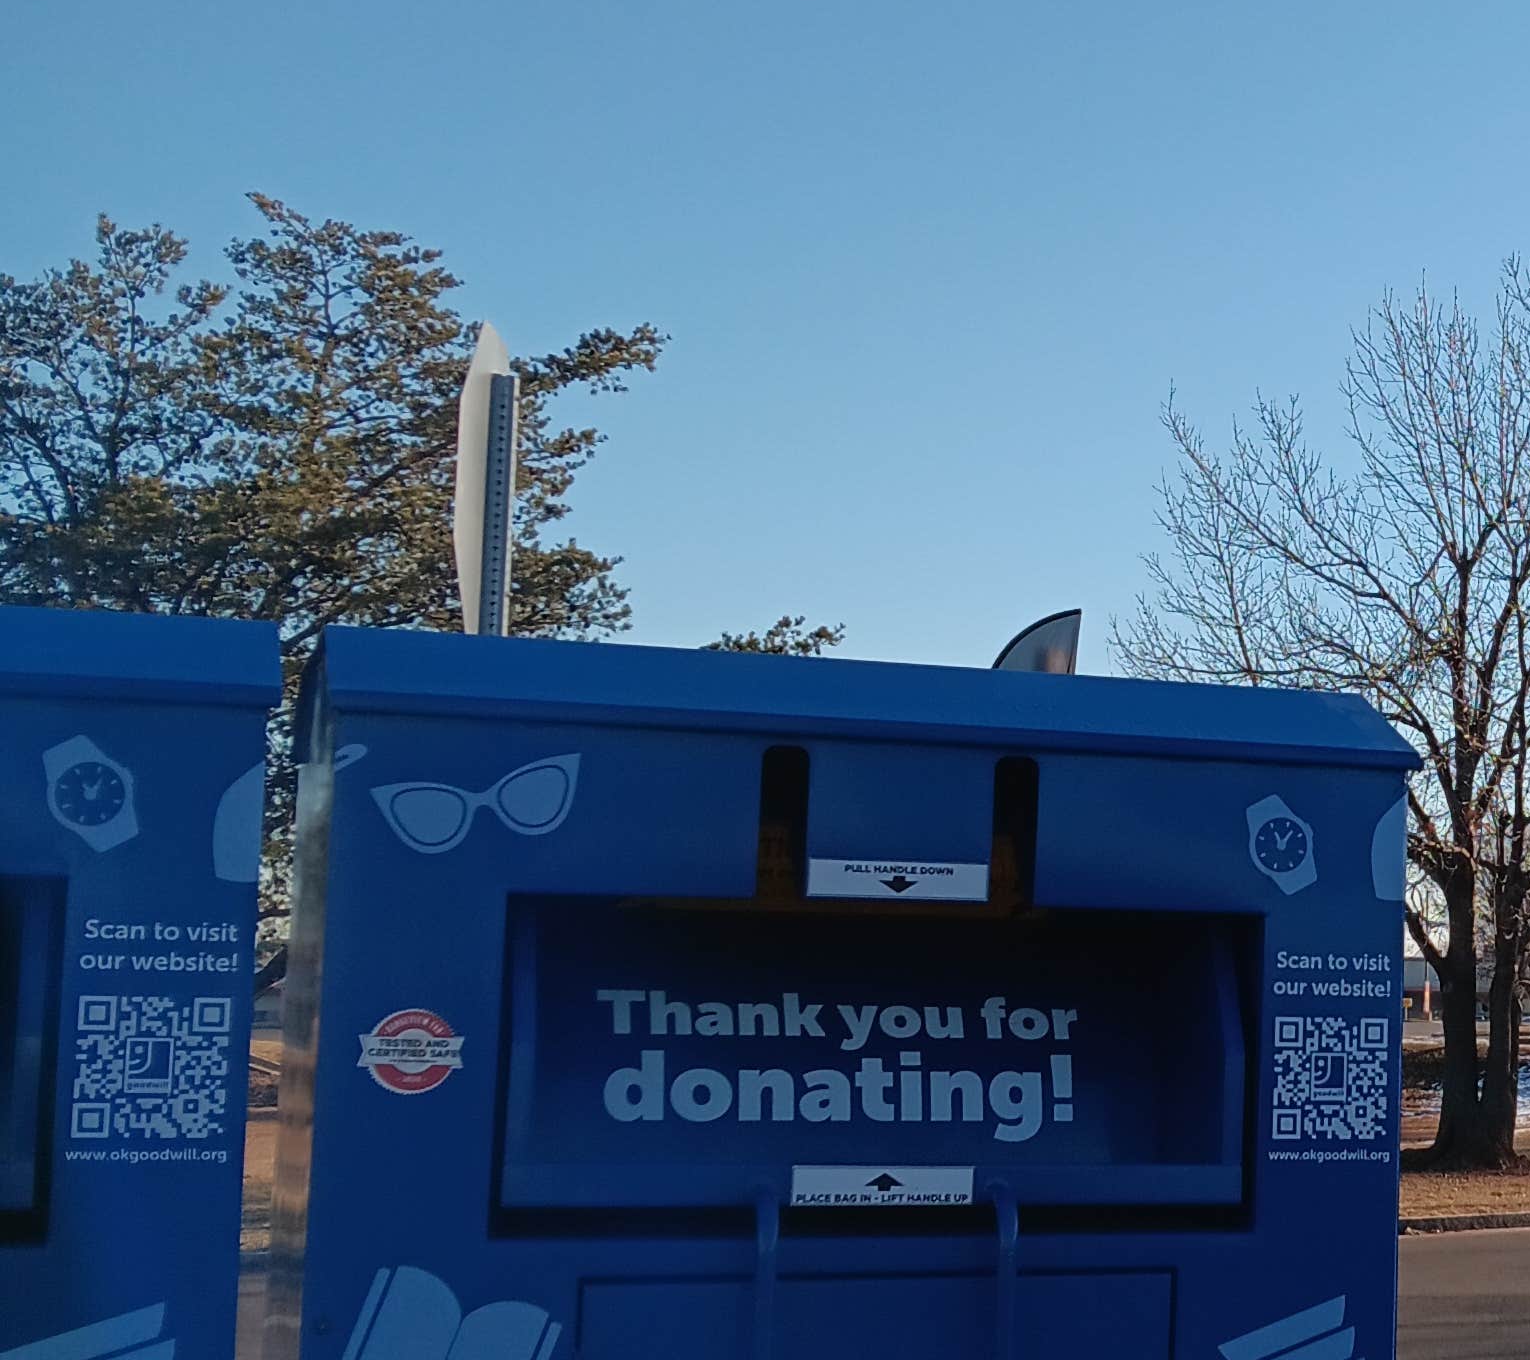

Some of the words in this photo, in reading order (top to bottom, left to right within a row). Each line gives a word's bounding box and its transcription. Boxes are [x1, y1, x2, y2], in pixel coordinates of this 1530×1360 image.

[844, 864, 871, 873] PULL
[873, 865, 917, 875] HANDLE
[920, 866, 954, 876] DOWN
[84, 919, 145, 939] Scan
[154, 922, 179, 940] to
[186, 922, 238, 942] visit
[79, 954, 125, 970] our
[131, 952, 239, 972] website!
[1276, 951, 1322, 969] Scan
[1328, 954, 1347, 970] to
[1352, 953, 1391, 971] visit
[1273, 981, 1308, 995] our
[1312, 979, 1391, 997] website!
[597, 989, 826, 1037] Thank
[837, 1003, 965, 1050] you
[980, 996, 1078, 1040] for
[379, 1039, 422, 1048] TESTED
[425, 1040, 450, 1048] AND
[367, 1048, 426, 1058] CERTIFIED
[603, 1049, 1074, 1142] donating!
[65, 1148, 227, 1164] www.okgoodwill.org
[1268, 1148, 1390, 1163] www.okgoodwill.org
[795, 1193, 830, 1203] PLACE
[834, 1193, 857, 1203] BAG
[860, 1193, 872, 1203] IN
[881, 1193, 905, 1203] LIFT
[907, 1193, 951, 1203] HANDLE
[954, 1193, 969, 1203] UP
